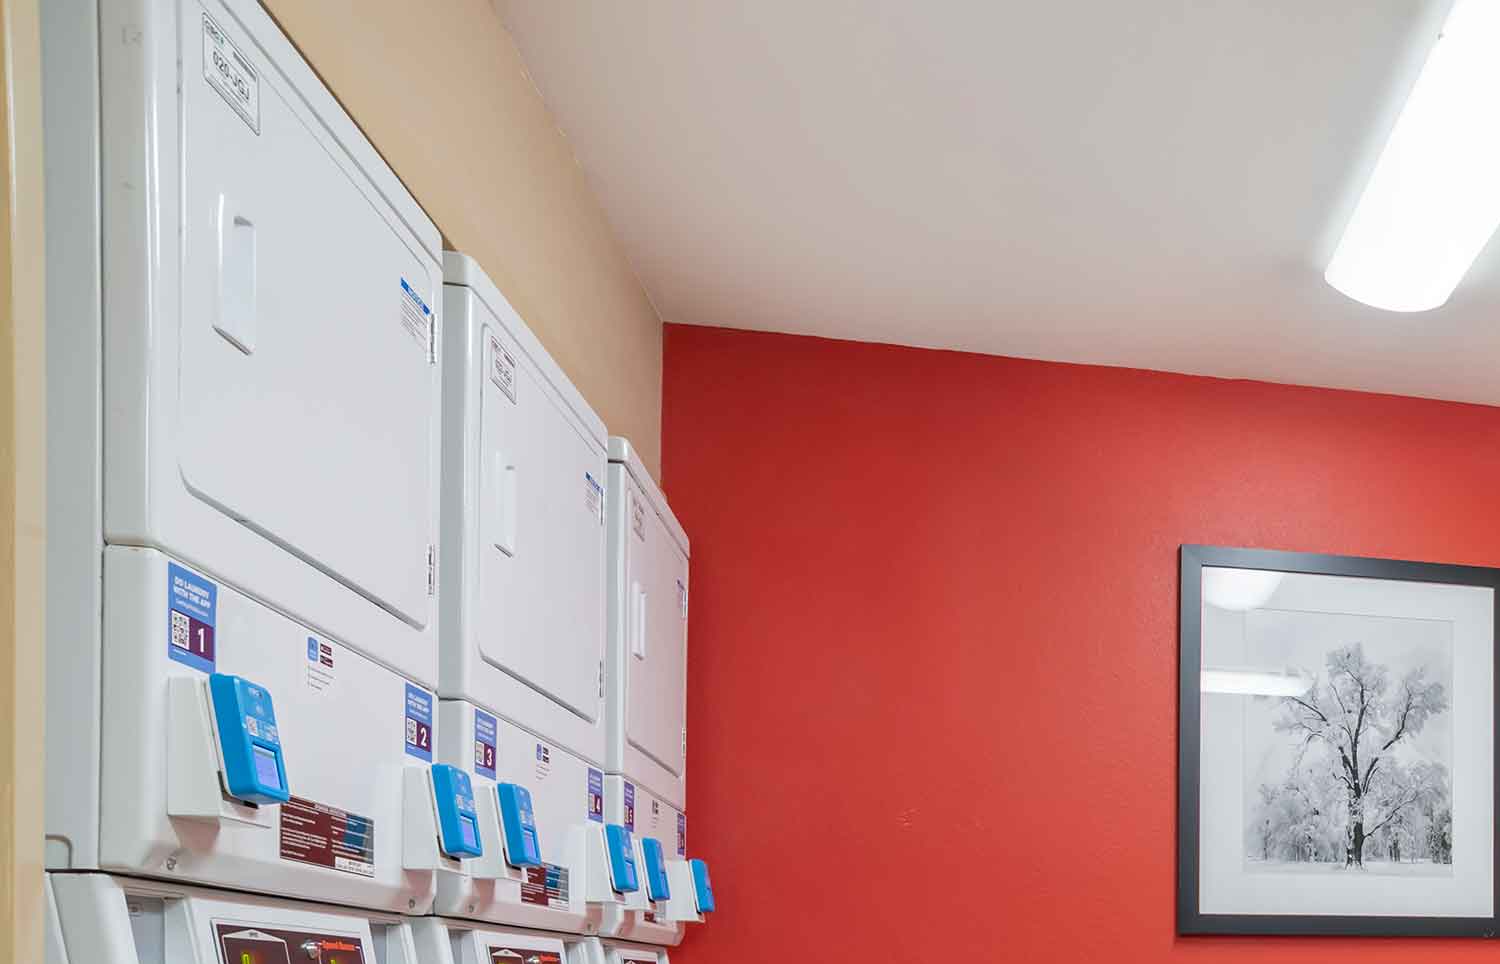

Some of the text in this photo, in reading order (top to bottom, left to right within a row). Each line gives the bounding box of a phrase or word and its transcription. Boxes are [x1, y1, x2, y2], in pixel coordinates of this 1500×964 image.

[198, 628, 205, 653] 1
[420, 727, 427, 747] 2
[486, 747, 493, 767] 3
